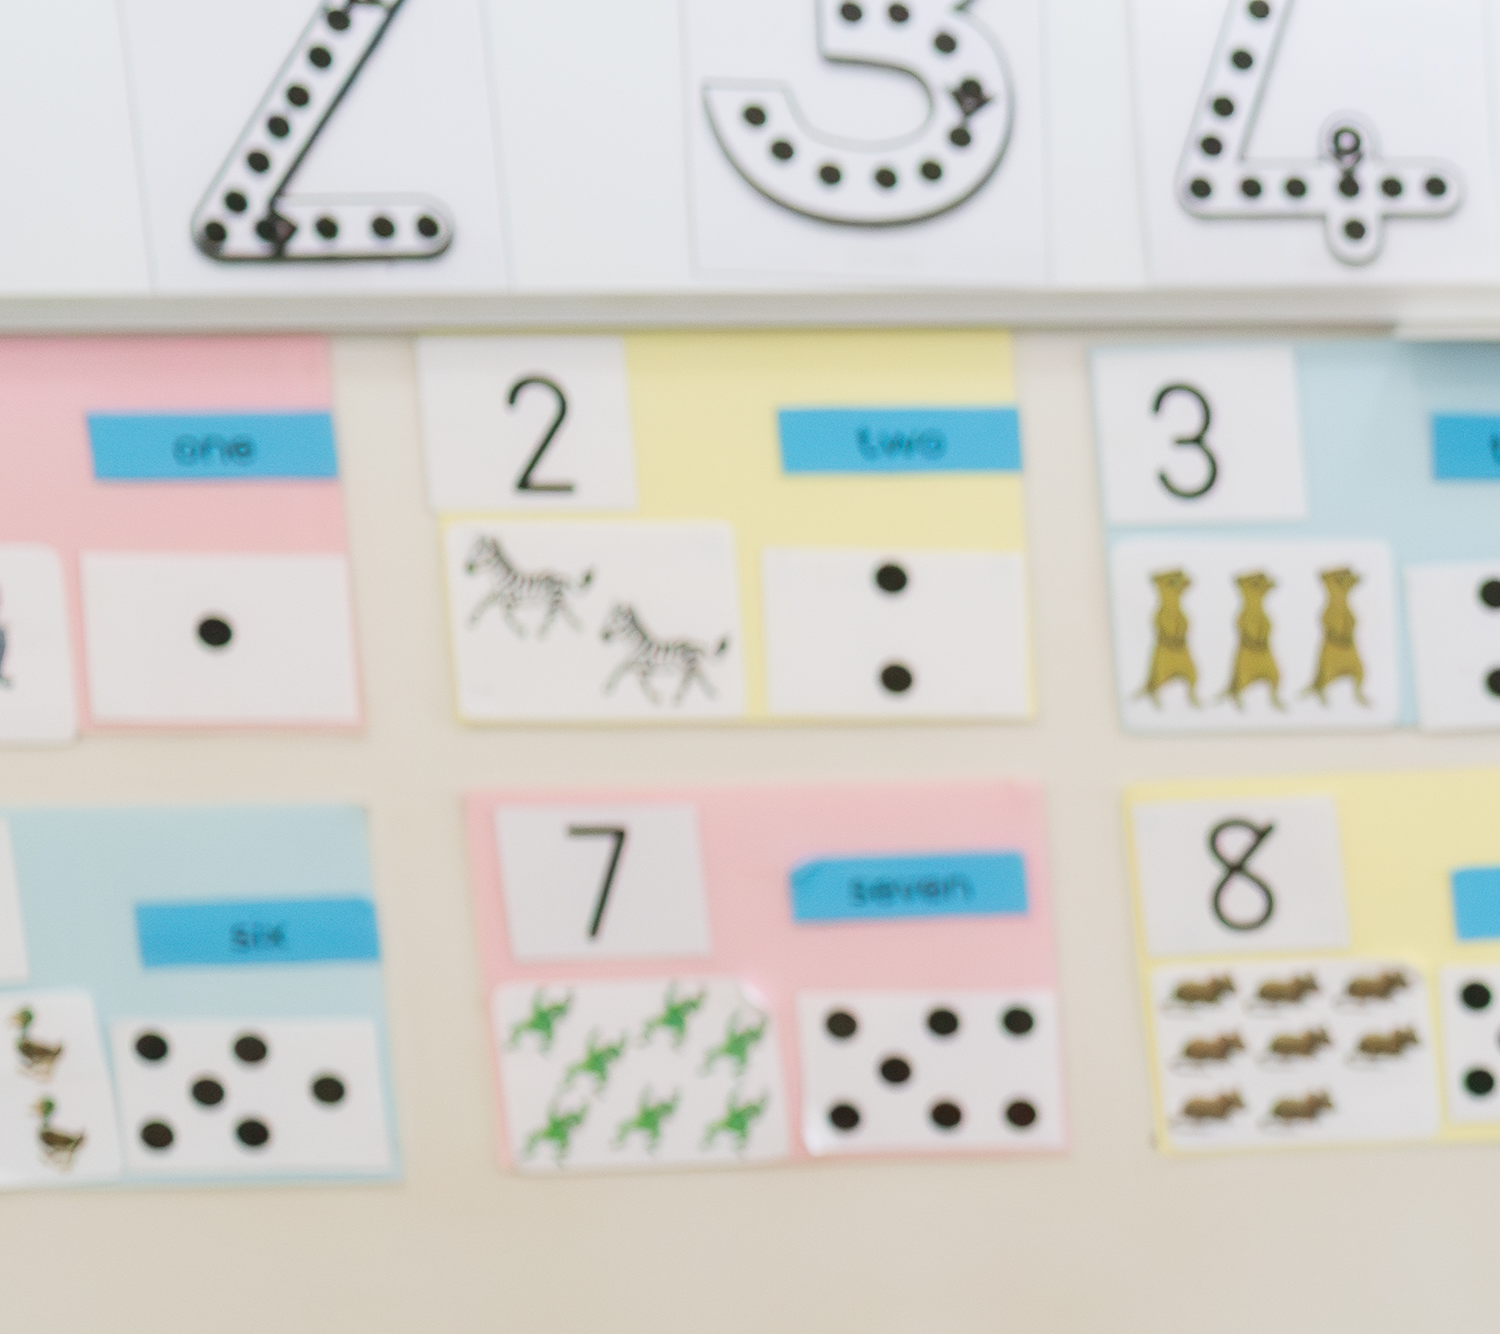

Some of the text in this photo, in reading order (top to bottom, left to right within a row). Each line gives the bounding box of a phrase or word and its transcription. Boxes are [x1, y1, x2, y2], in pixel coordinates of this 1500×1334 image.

[172, 432, 260, 467] one
[506, 374, 575, 494] 2
[855, 425, 948, 461] two
[1150, 381, 1220, 502] 3
[567, 824, 628, 940] 7
[845, 870, 978, 908] seven
[1206, 816, 1277, 933] 8
[230, 921, 290, 955] six
